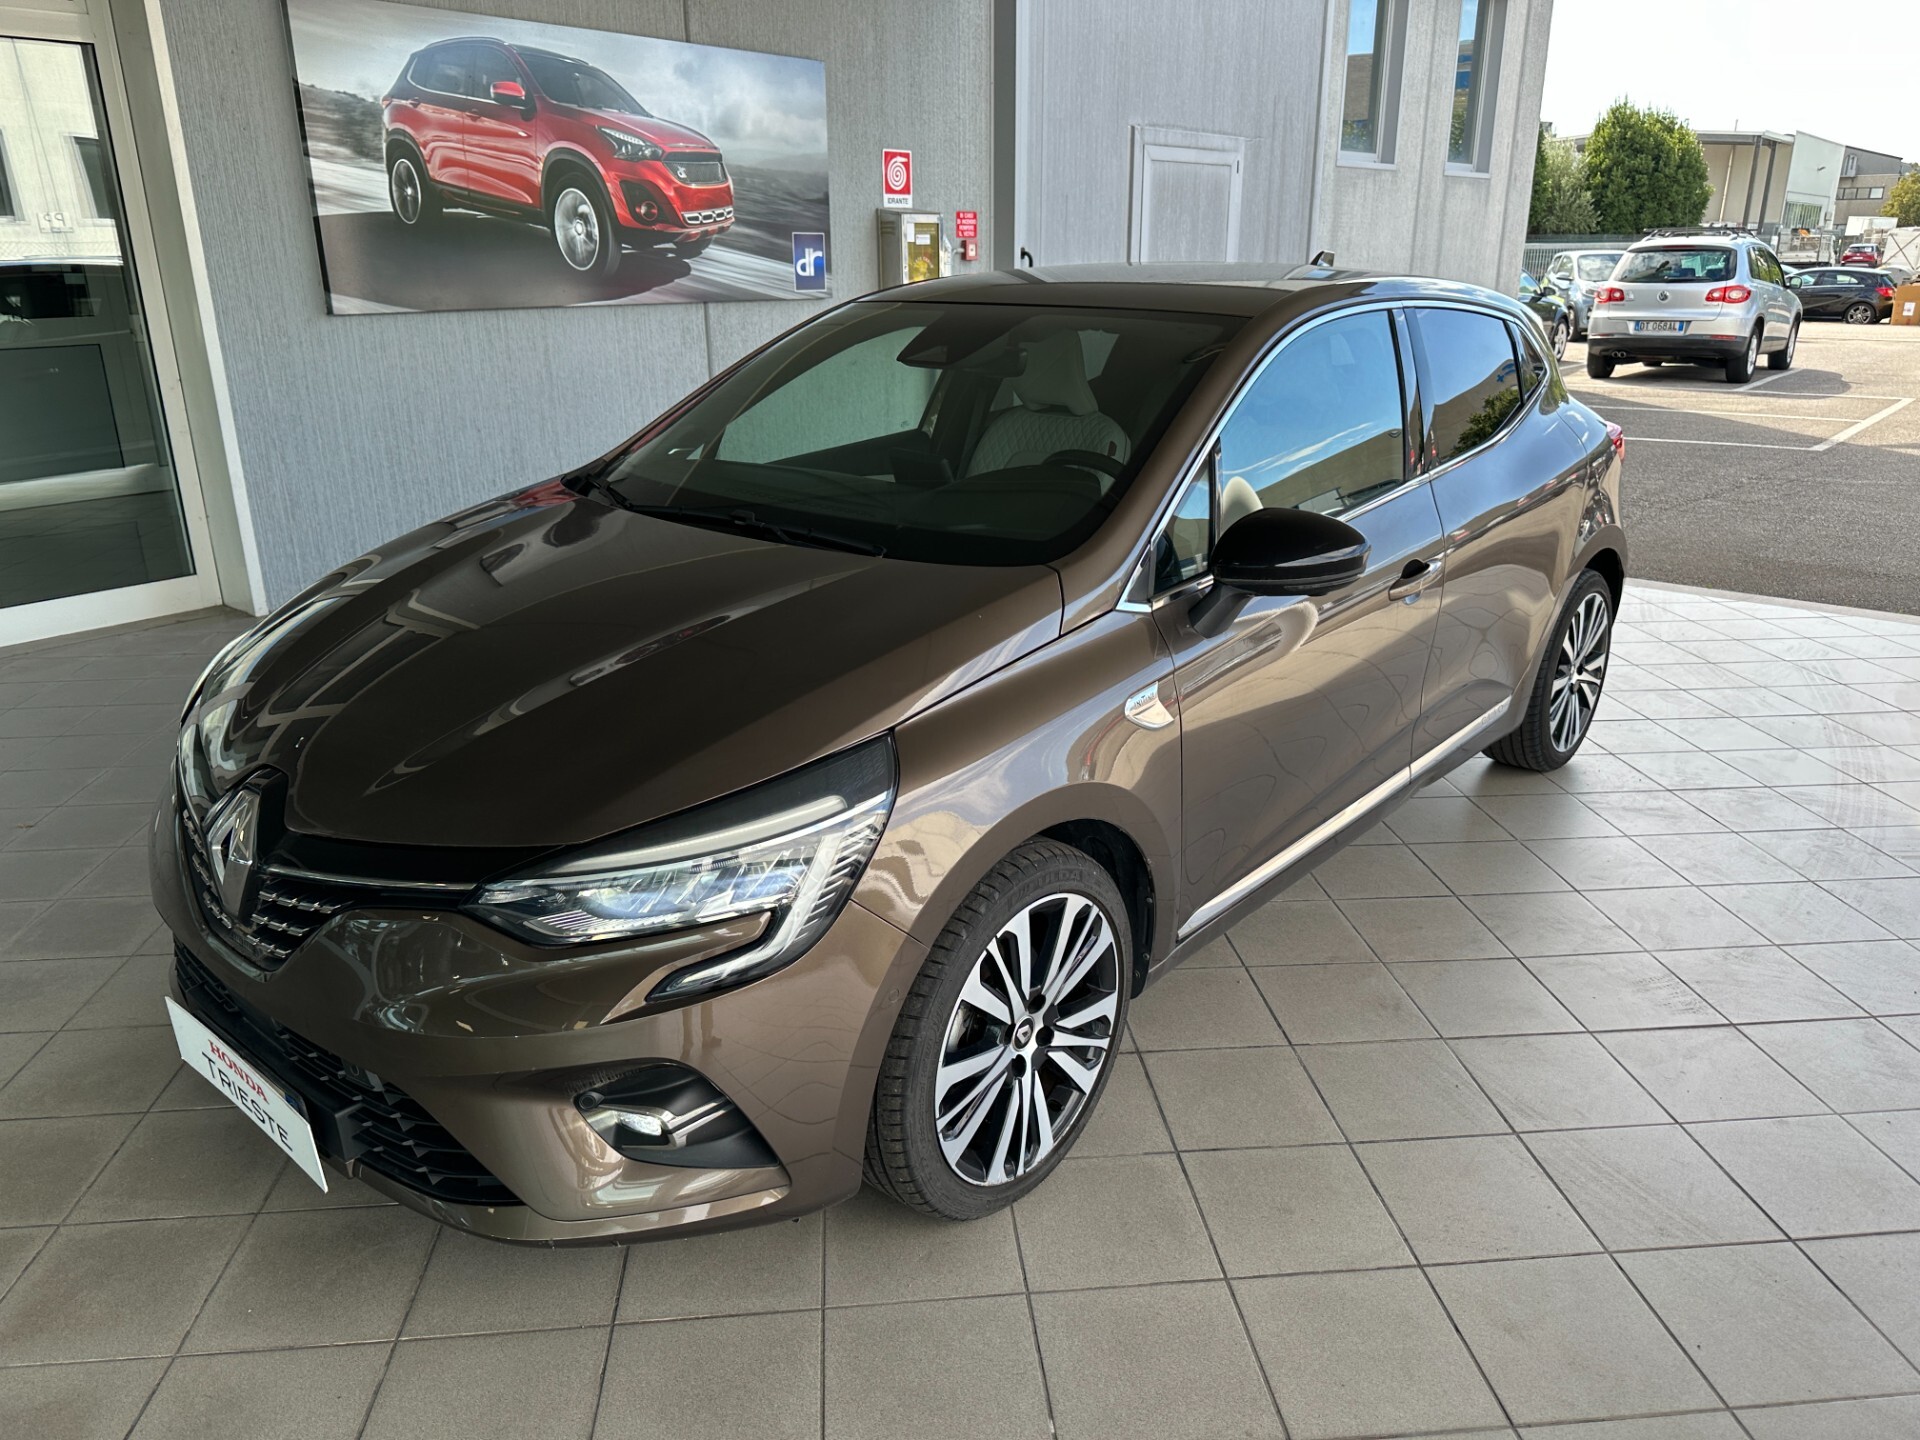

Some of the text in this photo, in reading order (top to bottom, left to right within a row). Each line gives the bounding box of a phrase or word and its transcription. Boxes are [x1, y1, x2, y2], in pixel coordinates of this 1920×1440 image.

[887, 197, 909, 205] IDRANTE
[796, 248, 823, 276] dr
[208, 1039, 270, 1105] HONDA
[202, 1051, 293, 1152] TRIESTE
